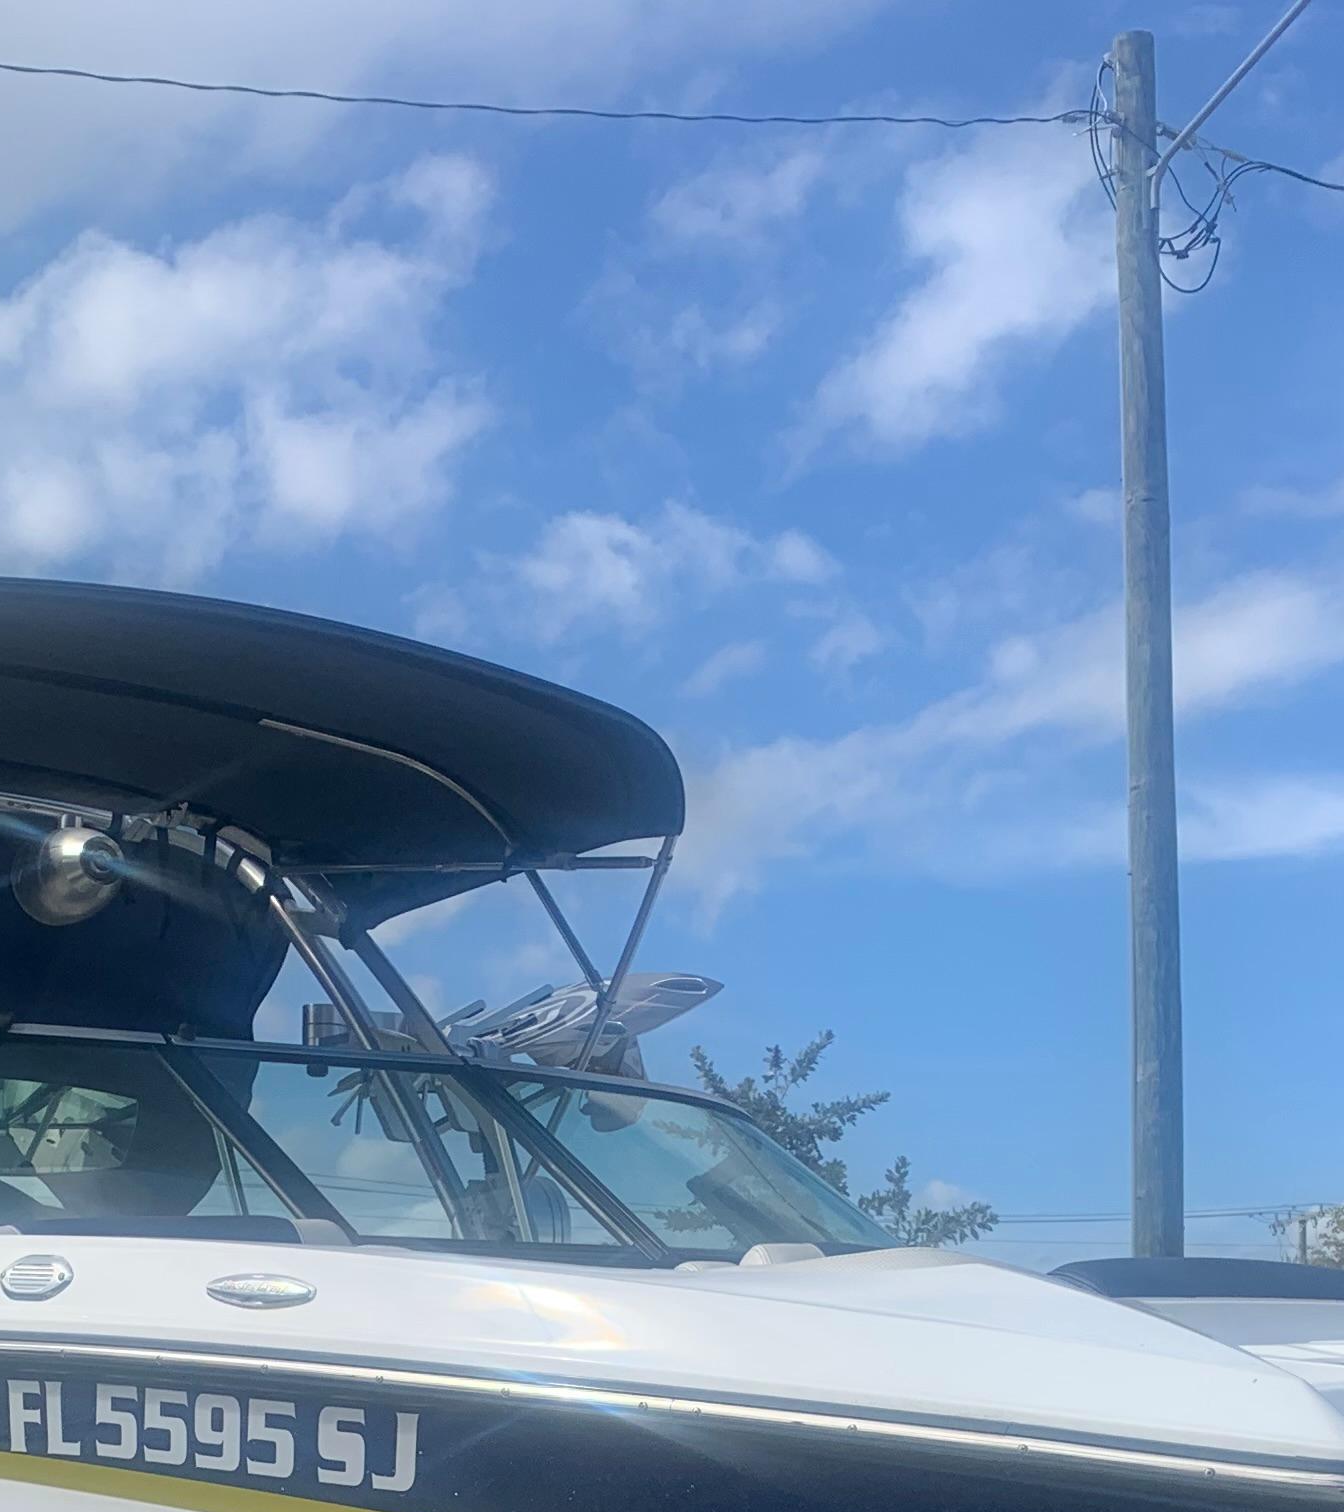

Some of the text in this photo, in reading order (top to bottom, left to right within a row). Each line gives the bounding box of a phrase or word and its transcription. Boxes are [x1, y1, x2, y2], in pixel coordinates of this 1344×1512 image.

[7, 1379, 420, 1492] FL 5595 SJ
